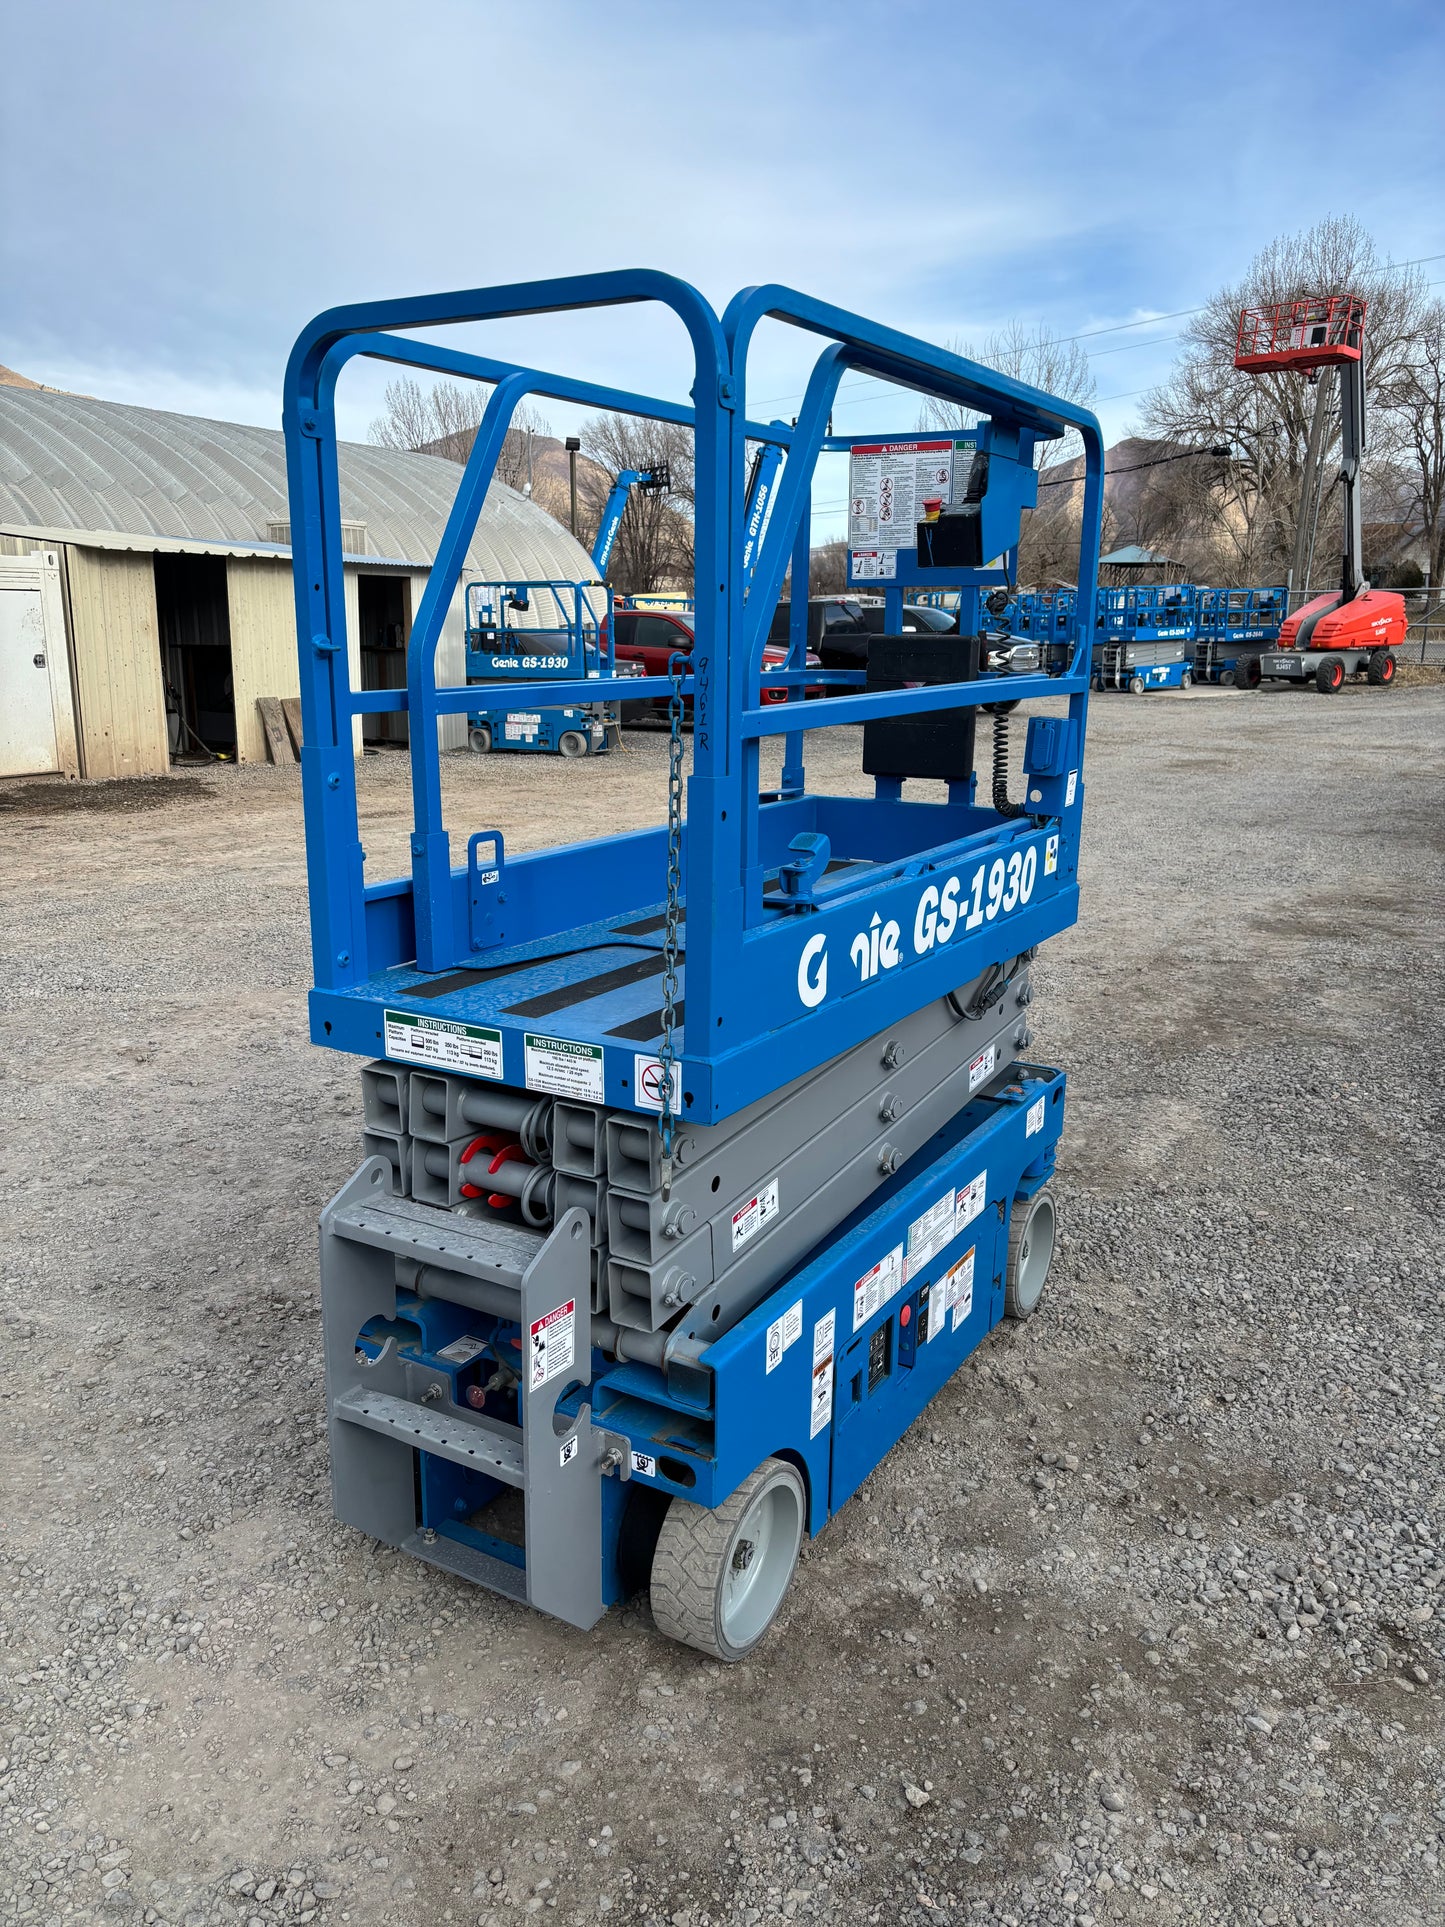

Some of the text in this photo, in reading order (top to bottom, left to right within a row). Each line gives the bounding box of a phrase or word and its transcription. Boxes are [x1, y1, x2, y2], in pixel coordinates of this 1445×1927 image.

[889, 444, 918, 452] DANGER
[750, 483, 768, 537] GTH-1056
[491, 656, 568, 669] Genie GS-1930
[797, 845, 1038, 1008] Gnie GS-1930
[418, 1019, 467, 1035] INSTRUCTIONS
[534, 1038, 592, 1056] INSTRUCTIONS
[544, 1305, 568, 1327] DANGER
